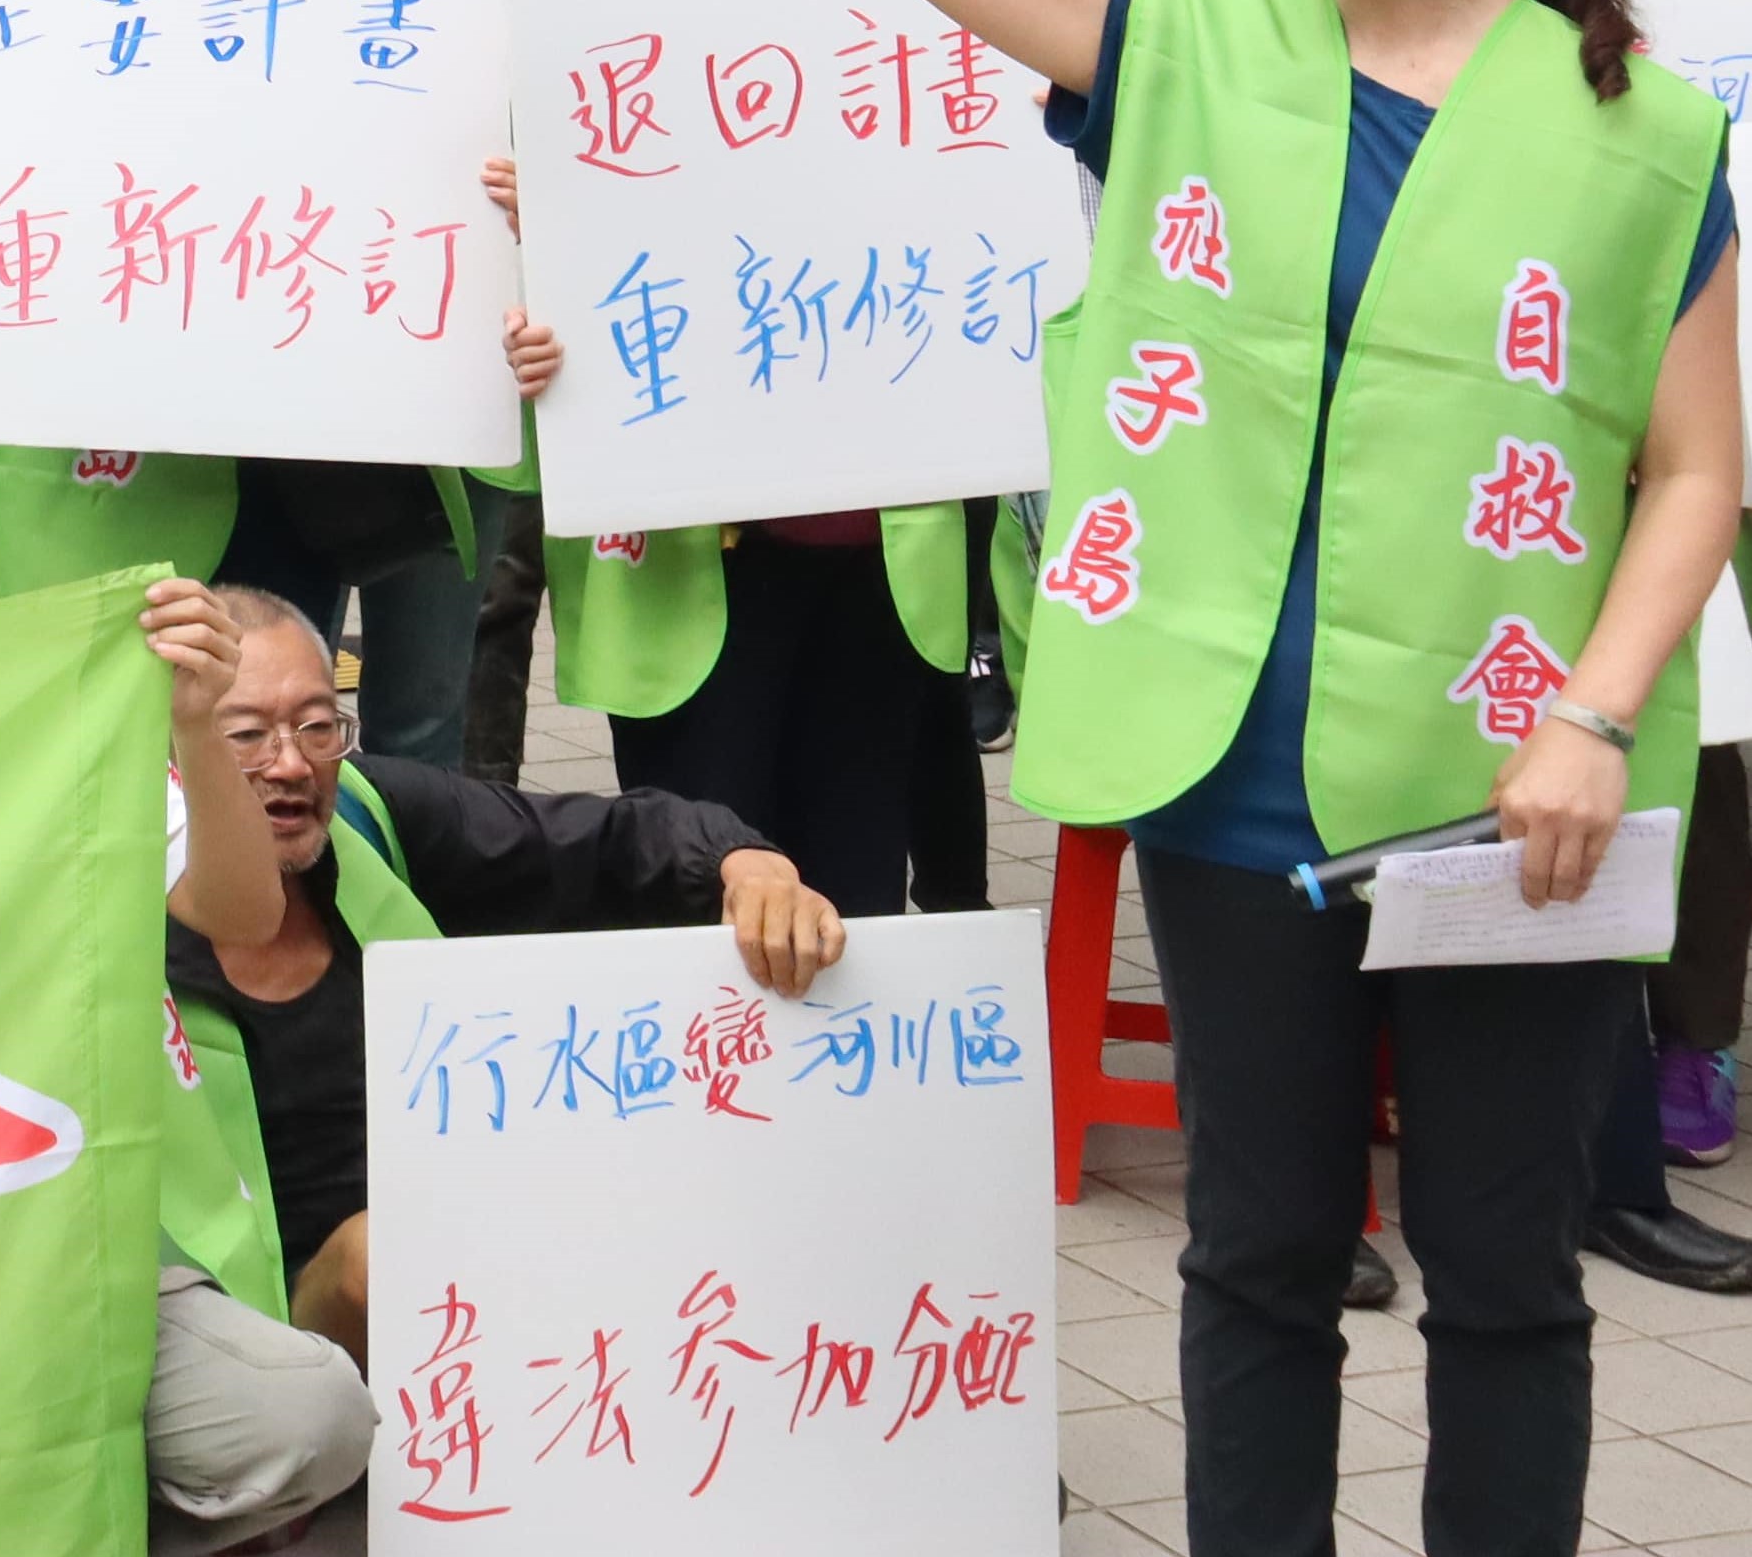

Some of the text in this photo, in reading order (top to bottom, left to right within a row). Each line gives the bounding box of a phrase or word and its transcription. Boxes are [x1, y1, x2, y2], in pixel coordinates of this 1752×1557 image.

[568, 9, 1010, 177] 退回計畫
[595, 233, 1049, 426] 重新修訂
[1044, 182, 1230, 618] 社子島
[1456, 265, 1584, 743] 自救會
[400, 986, 1023, 1135] 行水區變河川區
[398, 1270, 1036, 1522] 違法參加分配
